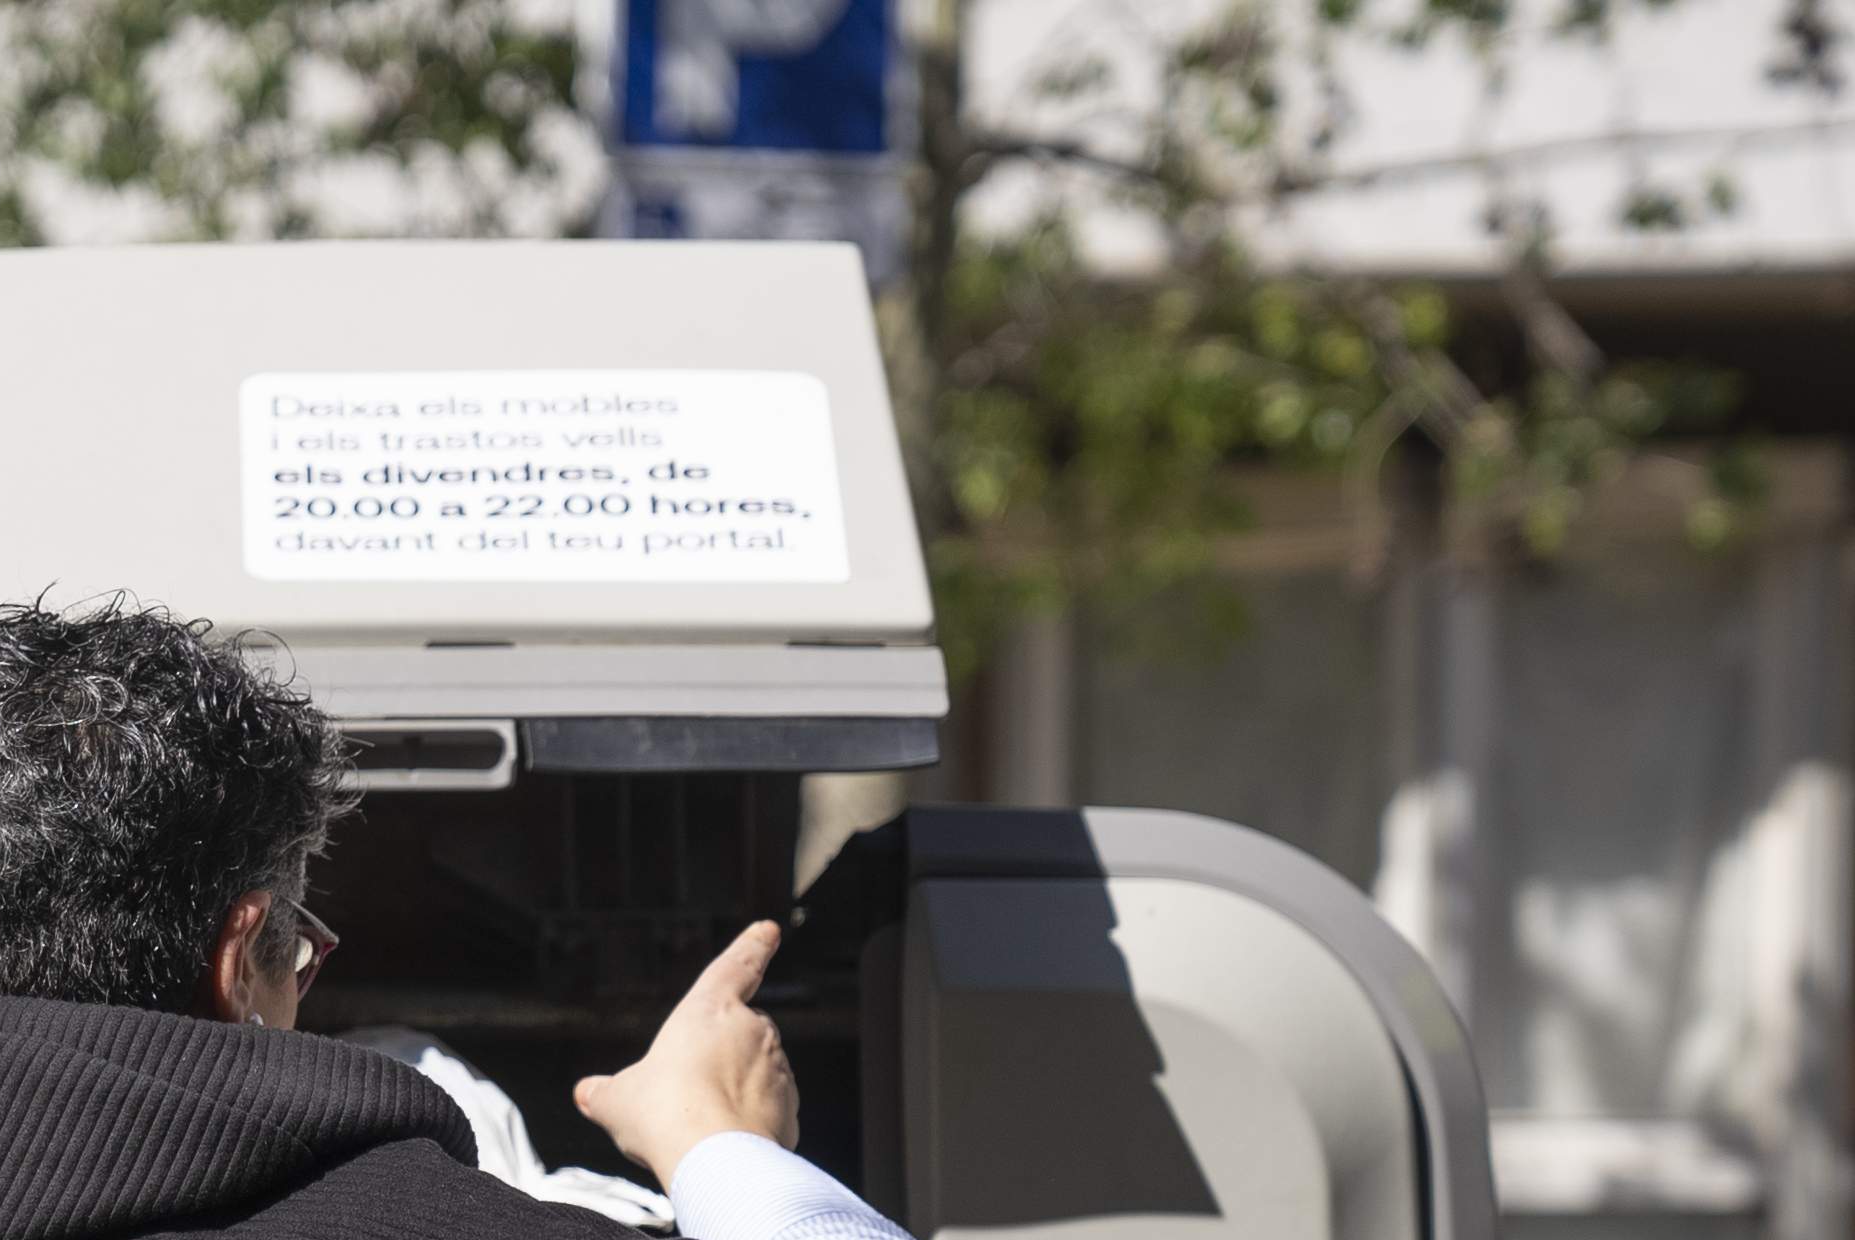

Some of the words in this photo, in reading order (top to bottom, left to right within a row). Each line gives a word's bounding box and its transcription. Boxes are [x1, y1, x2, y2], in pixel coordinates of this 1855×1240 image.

[270, 395, 401, 418] Deixa
[419, 395, 483, 416] els
[502, 394, 679, 415] mobles
[270, 429, 280, 450] i
[297, 430, 361, 450] els
[380, 430, 543, 451] trastos
[562, 427, 663, 449] vells
[274, 464, 342, 484] els
[362, 462, 630, 486] divendres,
[647, 459, 711, 481] de
[274, 496, 421, 519] 20.00
[440, 502, 467, 517] a
[484, 494, 633, 518] 22.00
[649, 494, 811, 520] hores,
[274, 530, 435, 551] davant
[457, 530, 529, 550] del
[548, 531, 623, 550] teu
